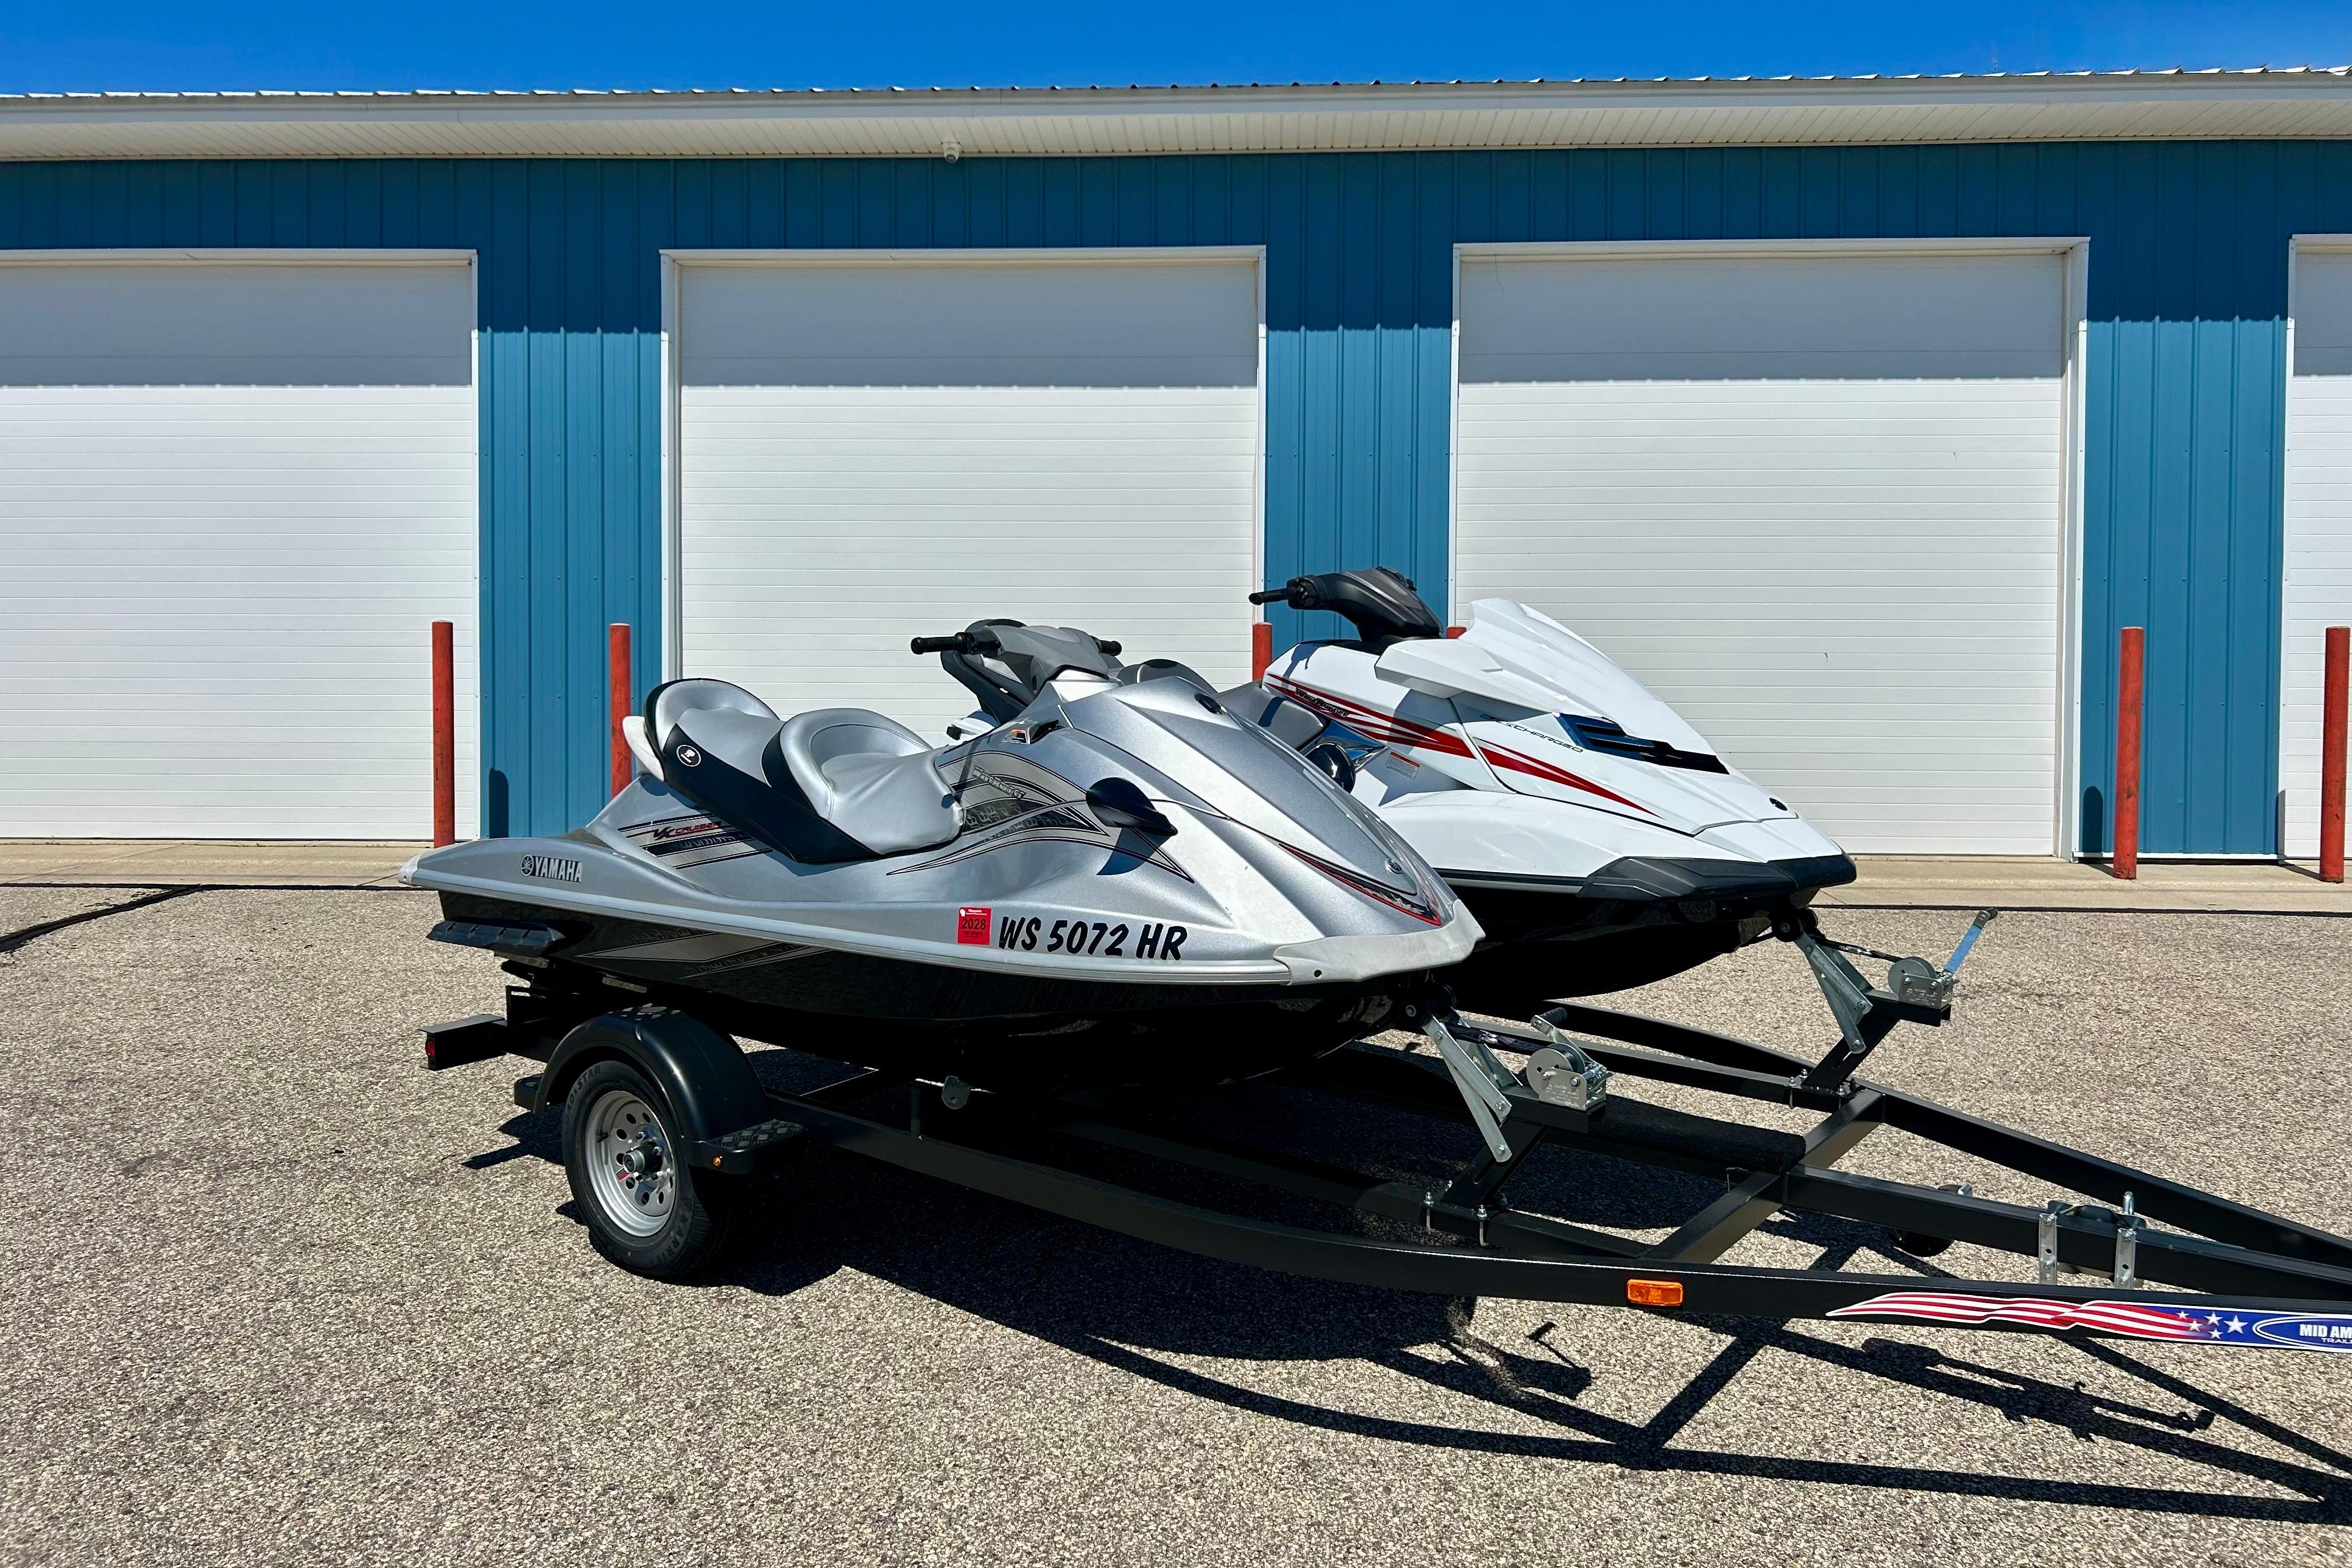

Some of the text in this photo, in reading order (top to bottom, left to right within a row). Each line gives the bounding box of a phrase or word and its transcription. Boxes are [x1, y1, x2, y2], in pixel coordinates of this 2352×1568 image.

[535, 856, 583, 883] YAMAHA
[961, 918, 987, 930] 2028
[998, 916, 1188, 961] WS 5072 HR
[2299, 1324, 2328, 1338] MID
